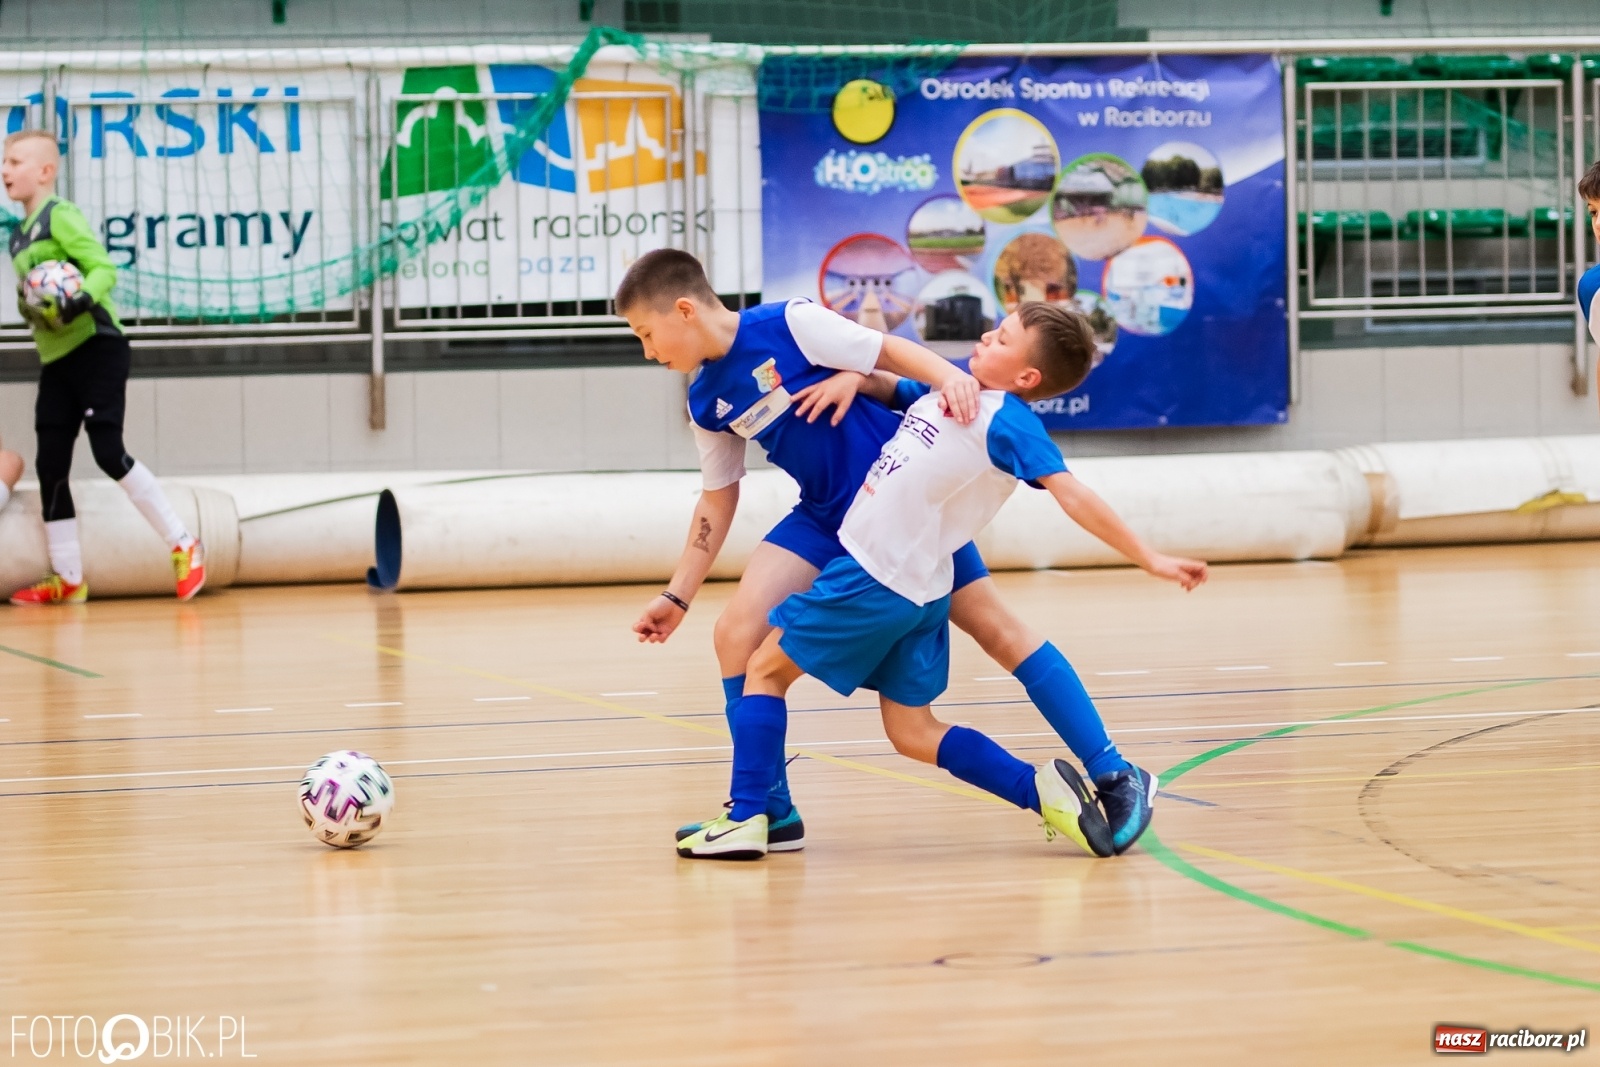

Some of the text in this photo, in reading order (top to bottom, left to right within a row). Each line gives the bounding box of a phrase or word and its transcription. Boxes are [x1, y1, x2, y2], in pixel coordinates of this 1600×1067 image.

[1019, 77, 1092, 101] Sportu
[1108, 76, 1211, 102] Rekreacji
[1076, 106, 1212, 127] w Raciborzu
[102, 209, 314, 268] gramy
